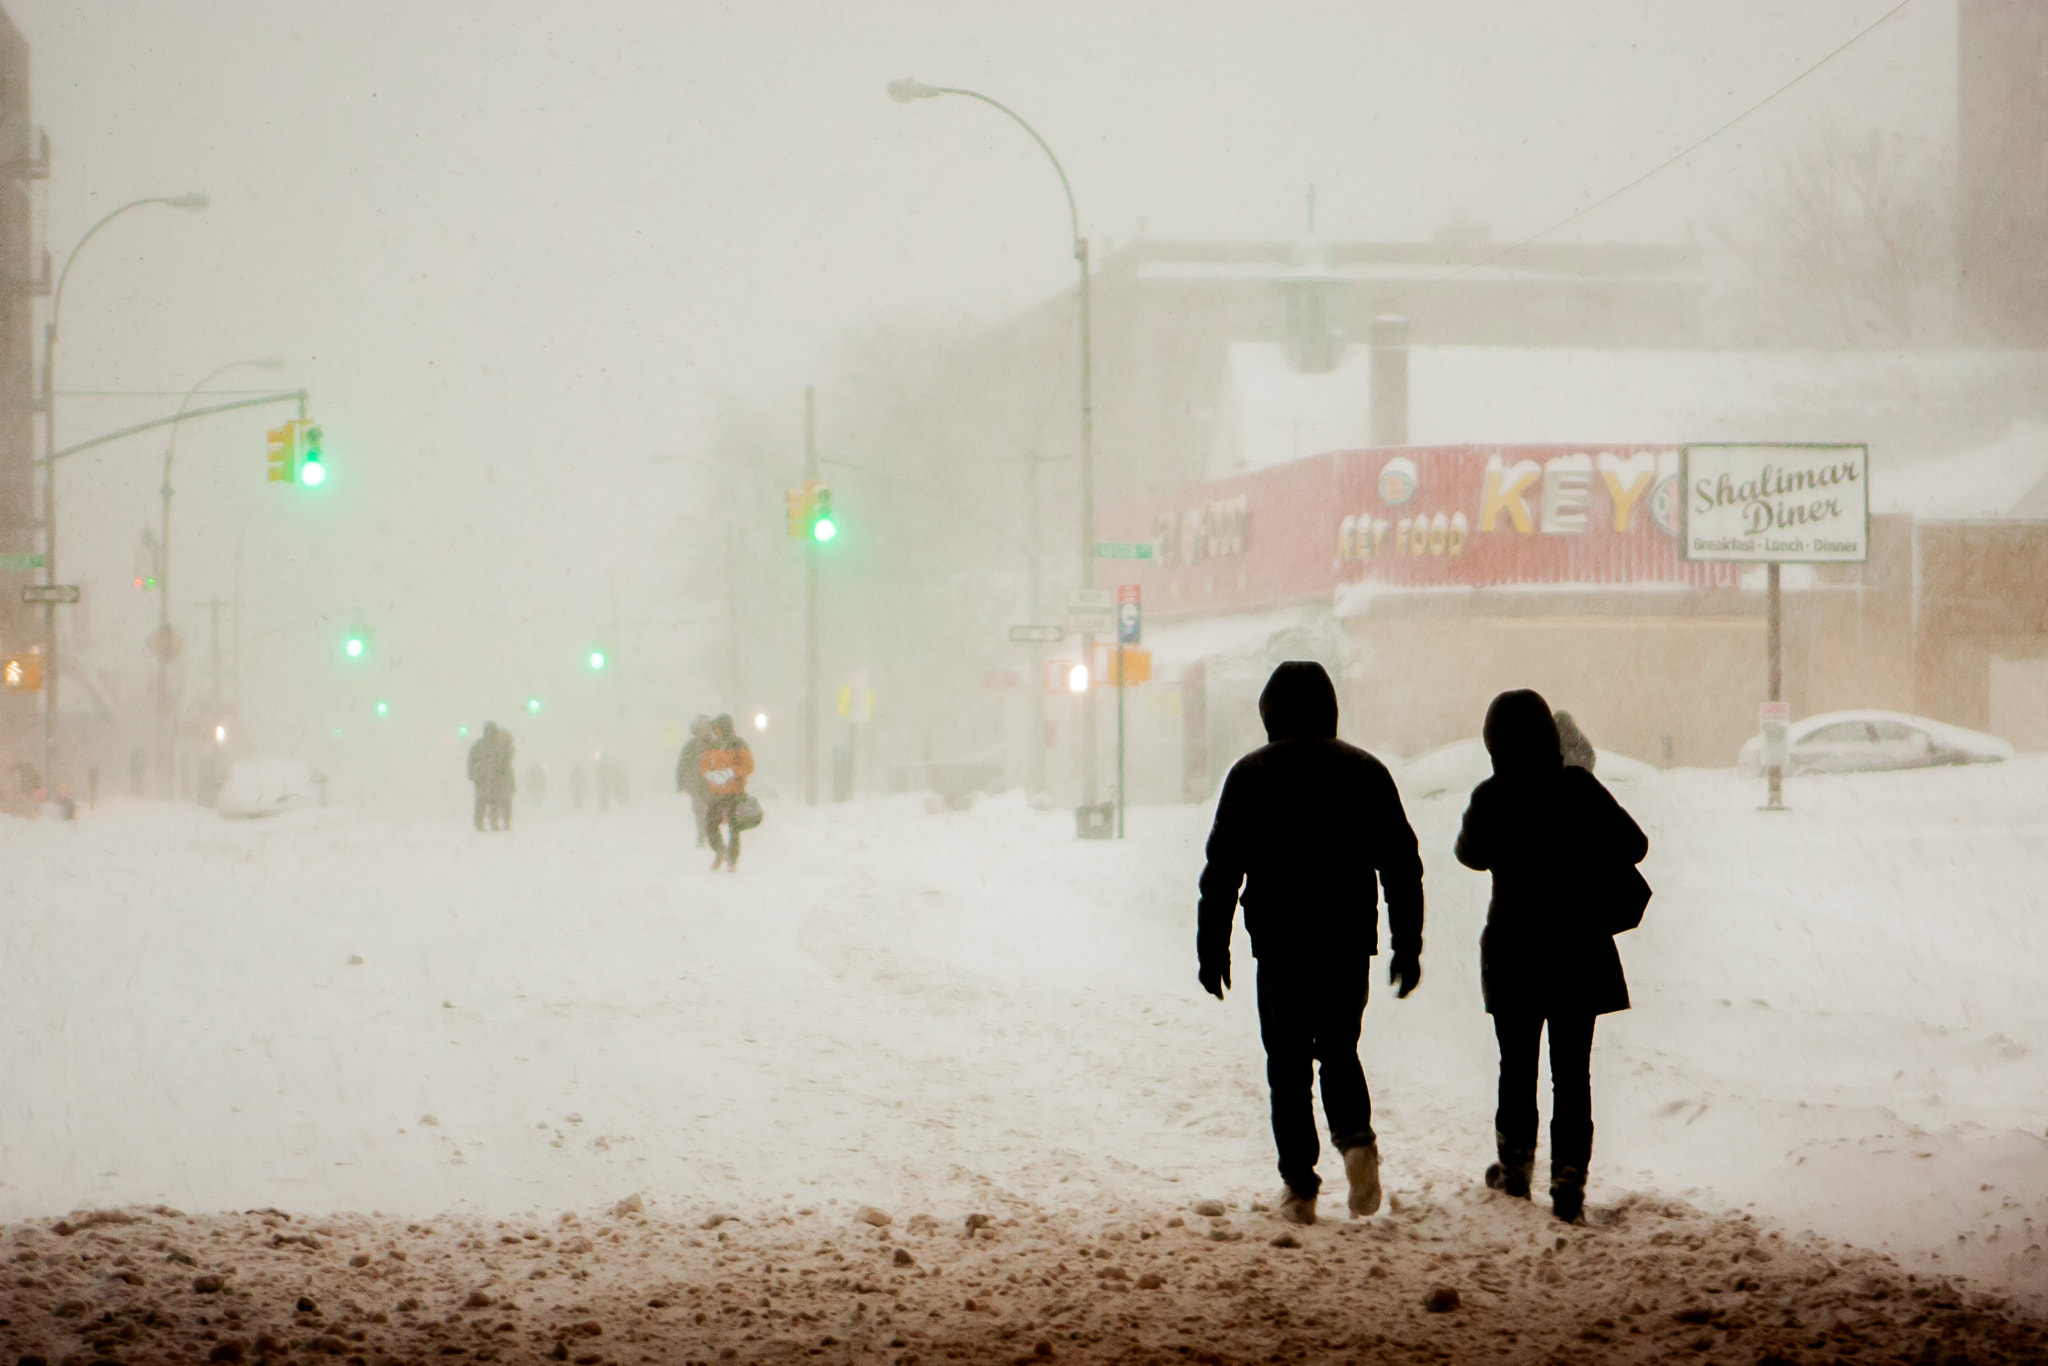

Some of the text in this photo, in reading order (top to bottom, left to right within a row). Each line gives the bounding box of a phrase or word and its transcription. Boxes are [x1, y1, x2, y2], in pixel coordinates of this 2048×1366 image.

[1480, 454, 1655, 535] KEY
[1695, 460, 1860, 514] Shalimar
[1338, 512, 1468, 560] KEY FOOD
[1742, 496, 1843, 536] Diner
[1694, 537, 1858, 552] Breakfast Lunch Dinner
